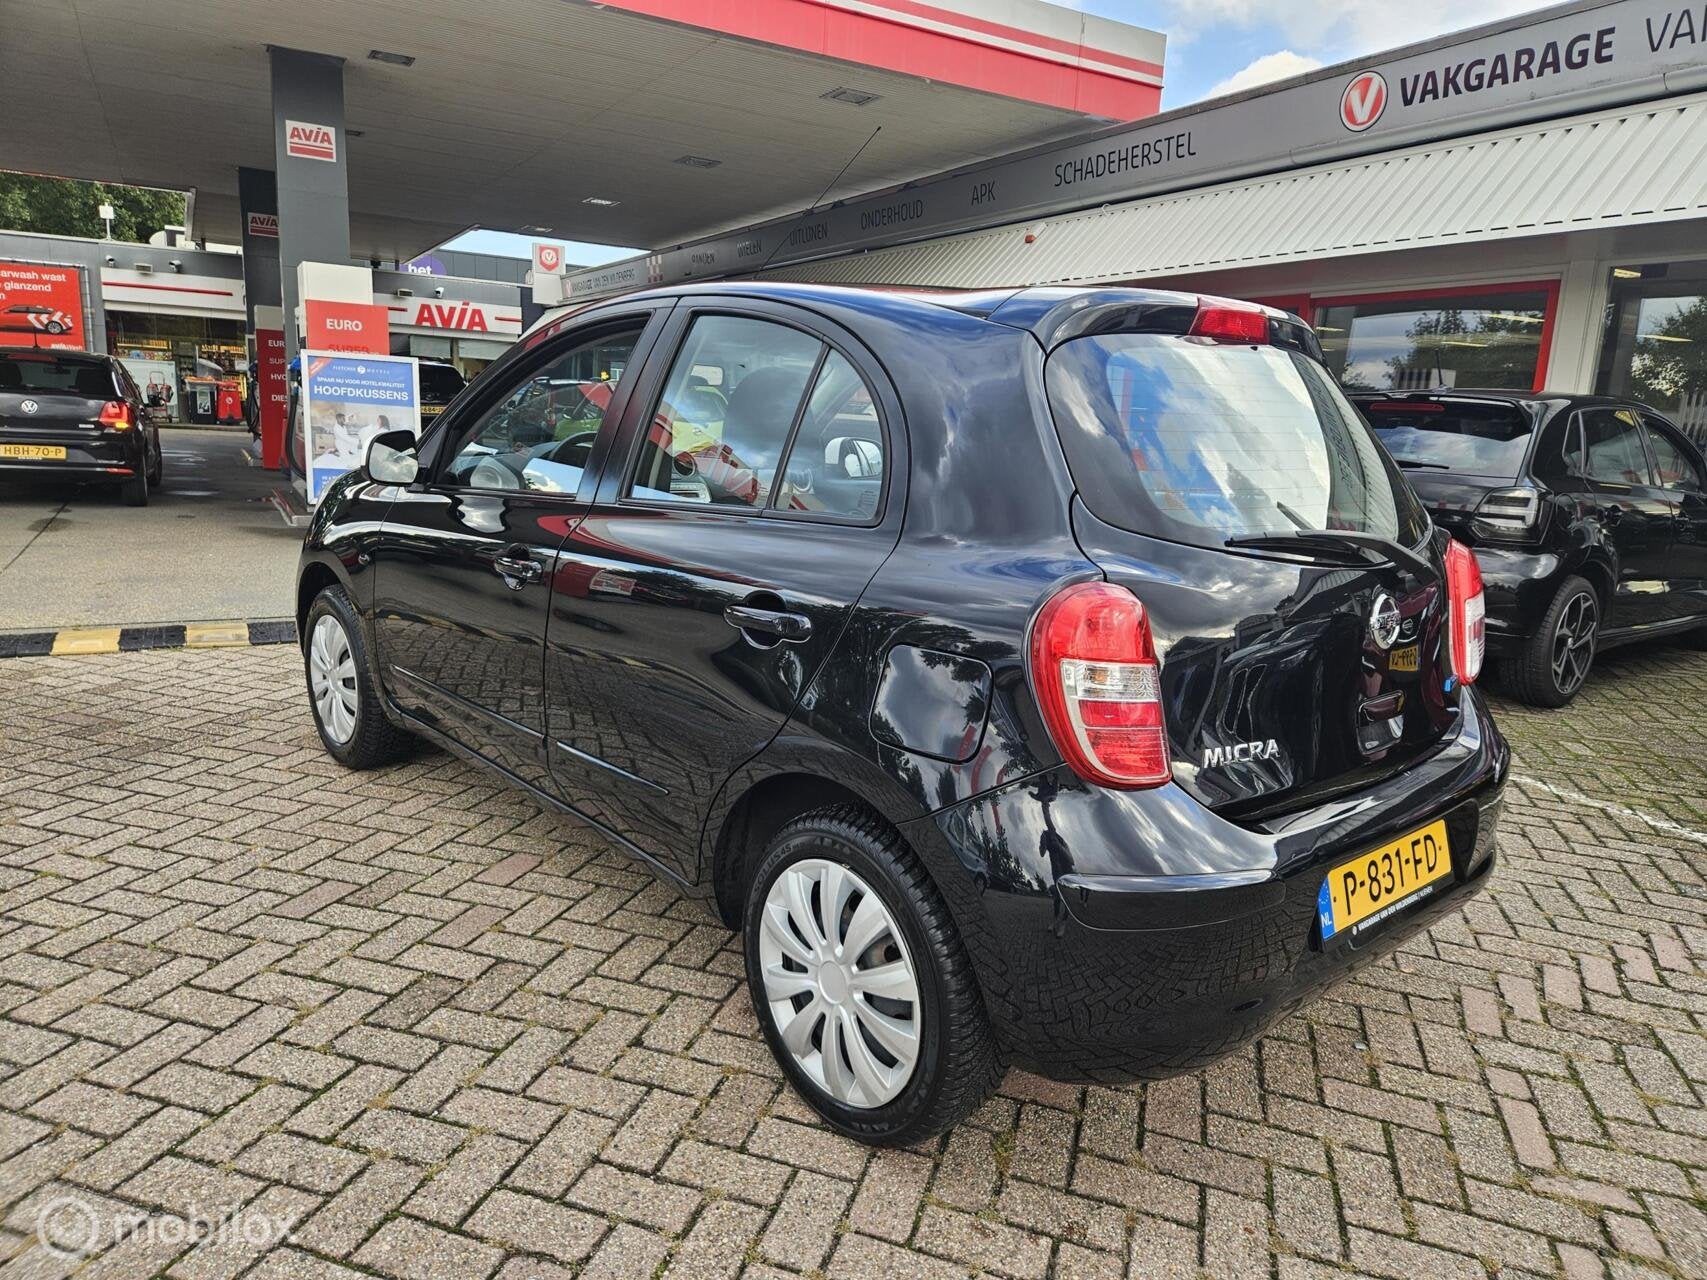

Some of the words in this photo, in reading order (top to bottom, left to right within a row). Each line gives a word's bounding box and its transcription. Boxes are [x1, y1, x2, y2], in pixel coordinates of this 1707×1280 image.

[1400, 26, 1616, 107] VAKGARAGE
[1645, 4, 1707, 53] VA
[290, 126, 334, 146] AVIA
[1054, 132, 1197, 187] SCHADEHERSTEL
[971, 181, 996, 206] APK
[861, 200, 923, 230] ONDERHOUD
[0, 270, 39, 280] arwash
[41, 273, 66, 282] wast
[4, 281, 52, 292] glanzend
[326, 318, 363, 332] EURO
[415, 300, 488, 332] AVIA
[268, 339, 285, 348] EUR
[314, 385, 409, 400] HOOFDKUSSENS
[4, 446, 62, 456] HBH-70-P
[1203, 739, 1280, 768] MICRA
[1320, 912, 1332, 928] NL
[1343, 834, 1437, 916] P-831-FD
